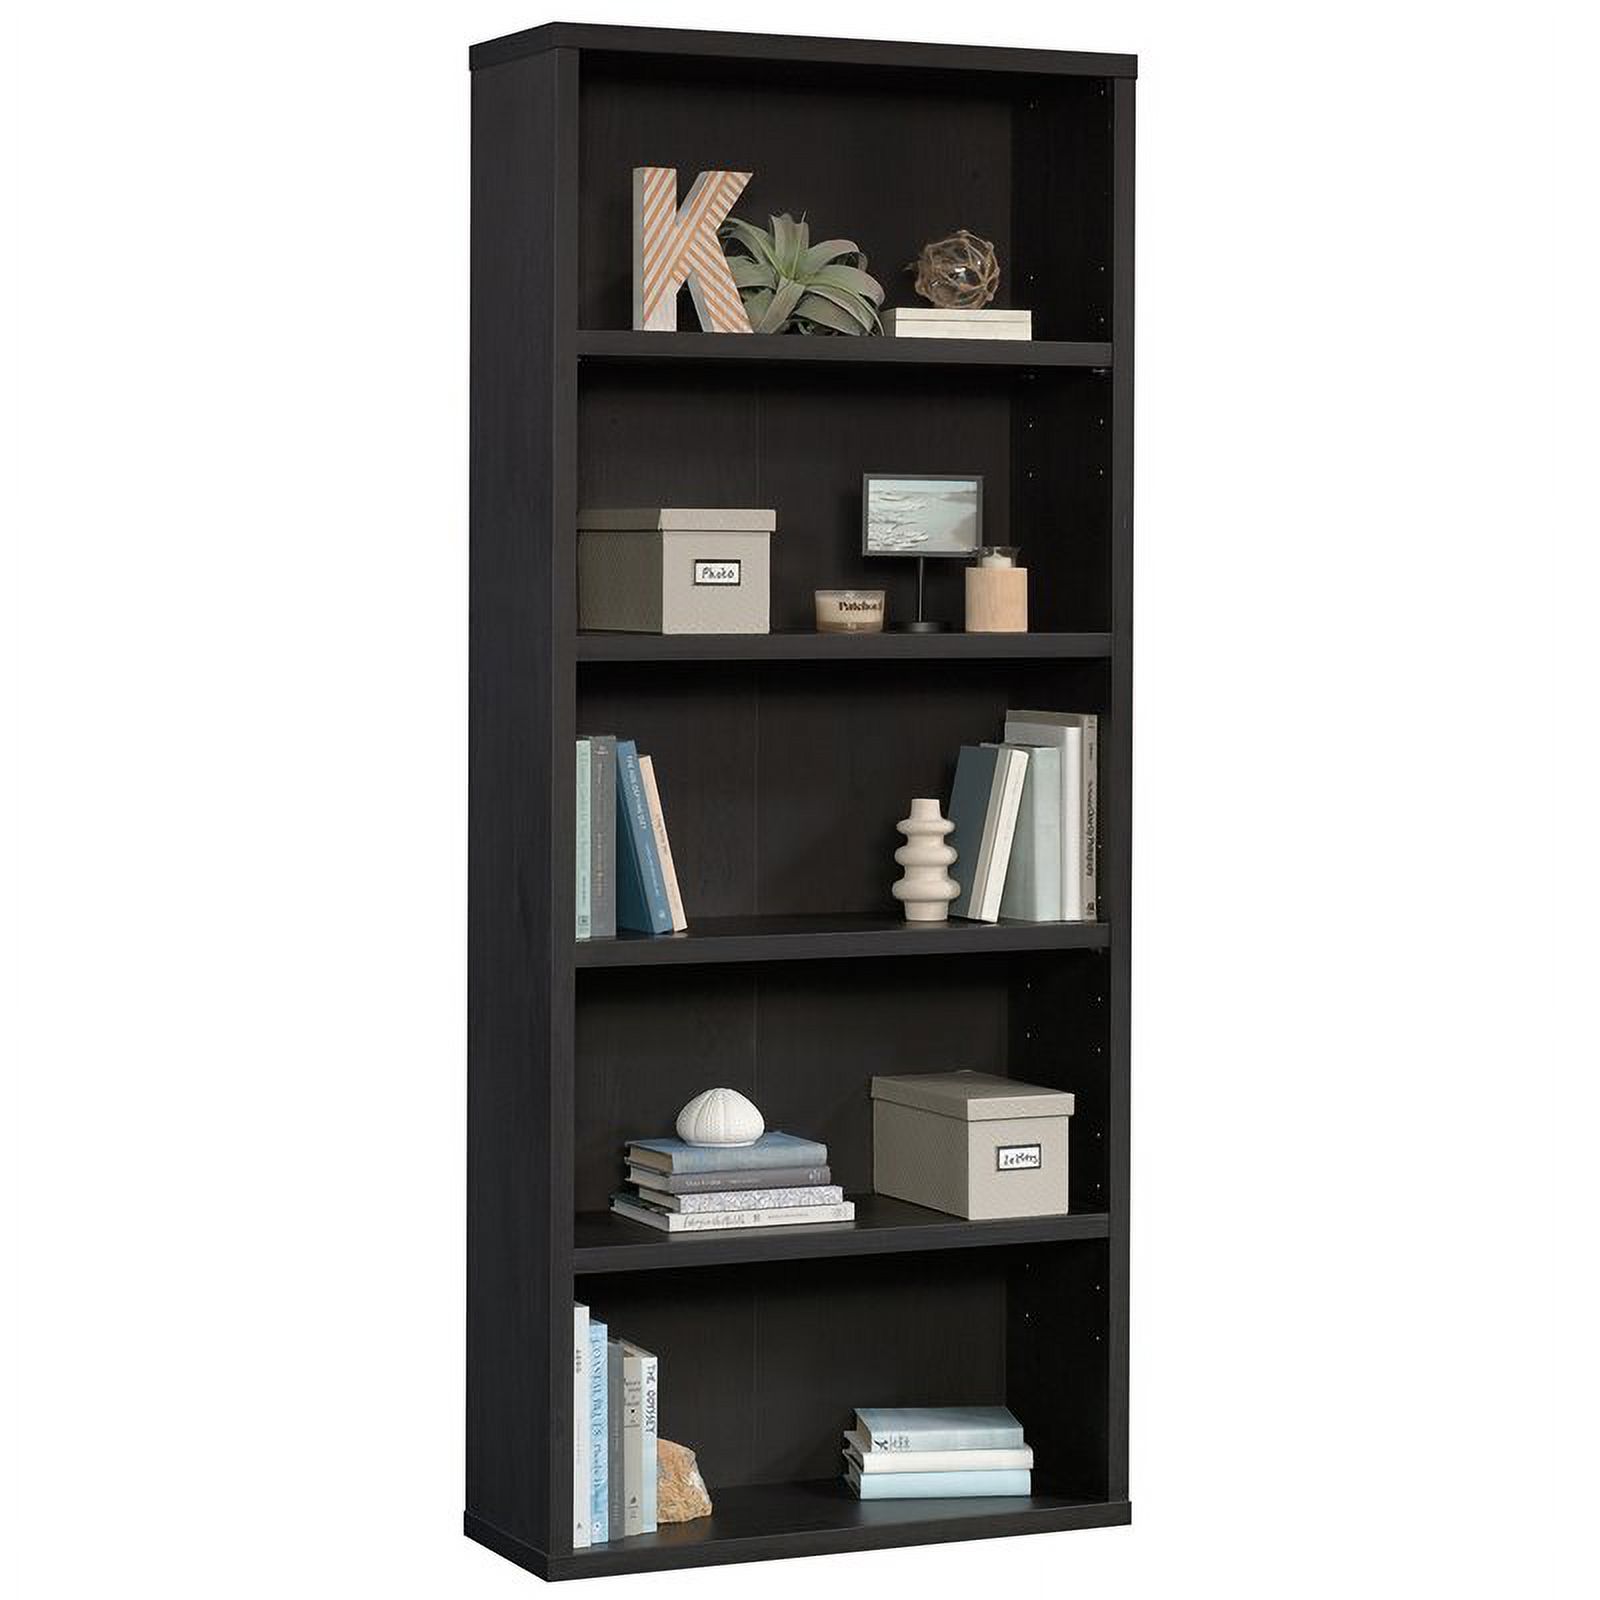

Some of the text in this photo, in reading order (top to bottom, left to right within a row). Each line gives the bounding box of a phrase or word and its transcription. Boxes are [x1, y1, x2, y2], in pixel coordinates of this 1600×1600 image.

[633, 167, 753, 334] K
[702, 566, 735, 579] Photo
[645, 1364, 656, 1435] THE ODYSSEY
